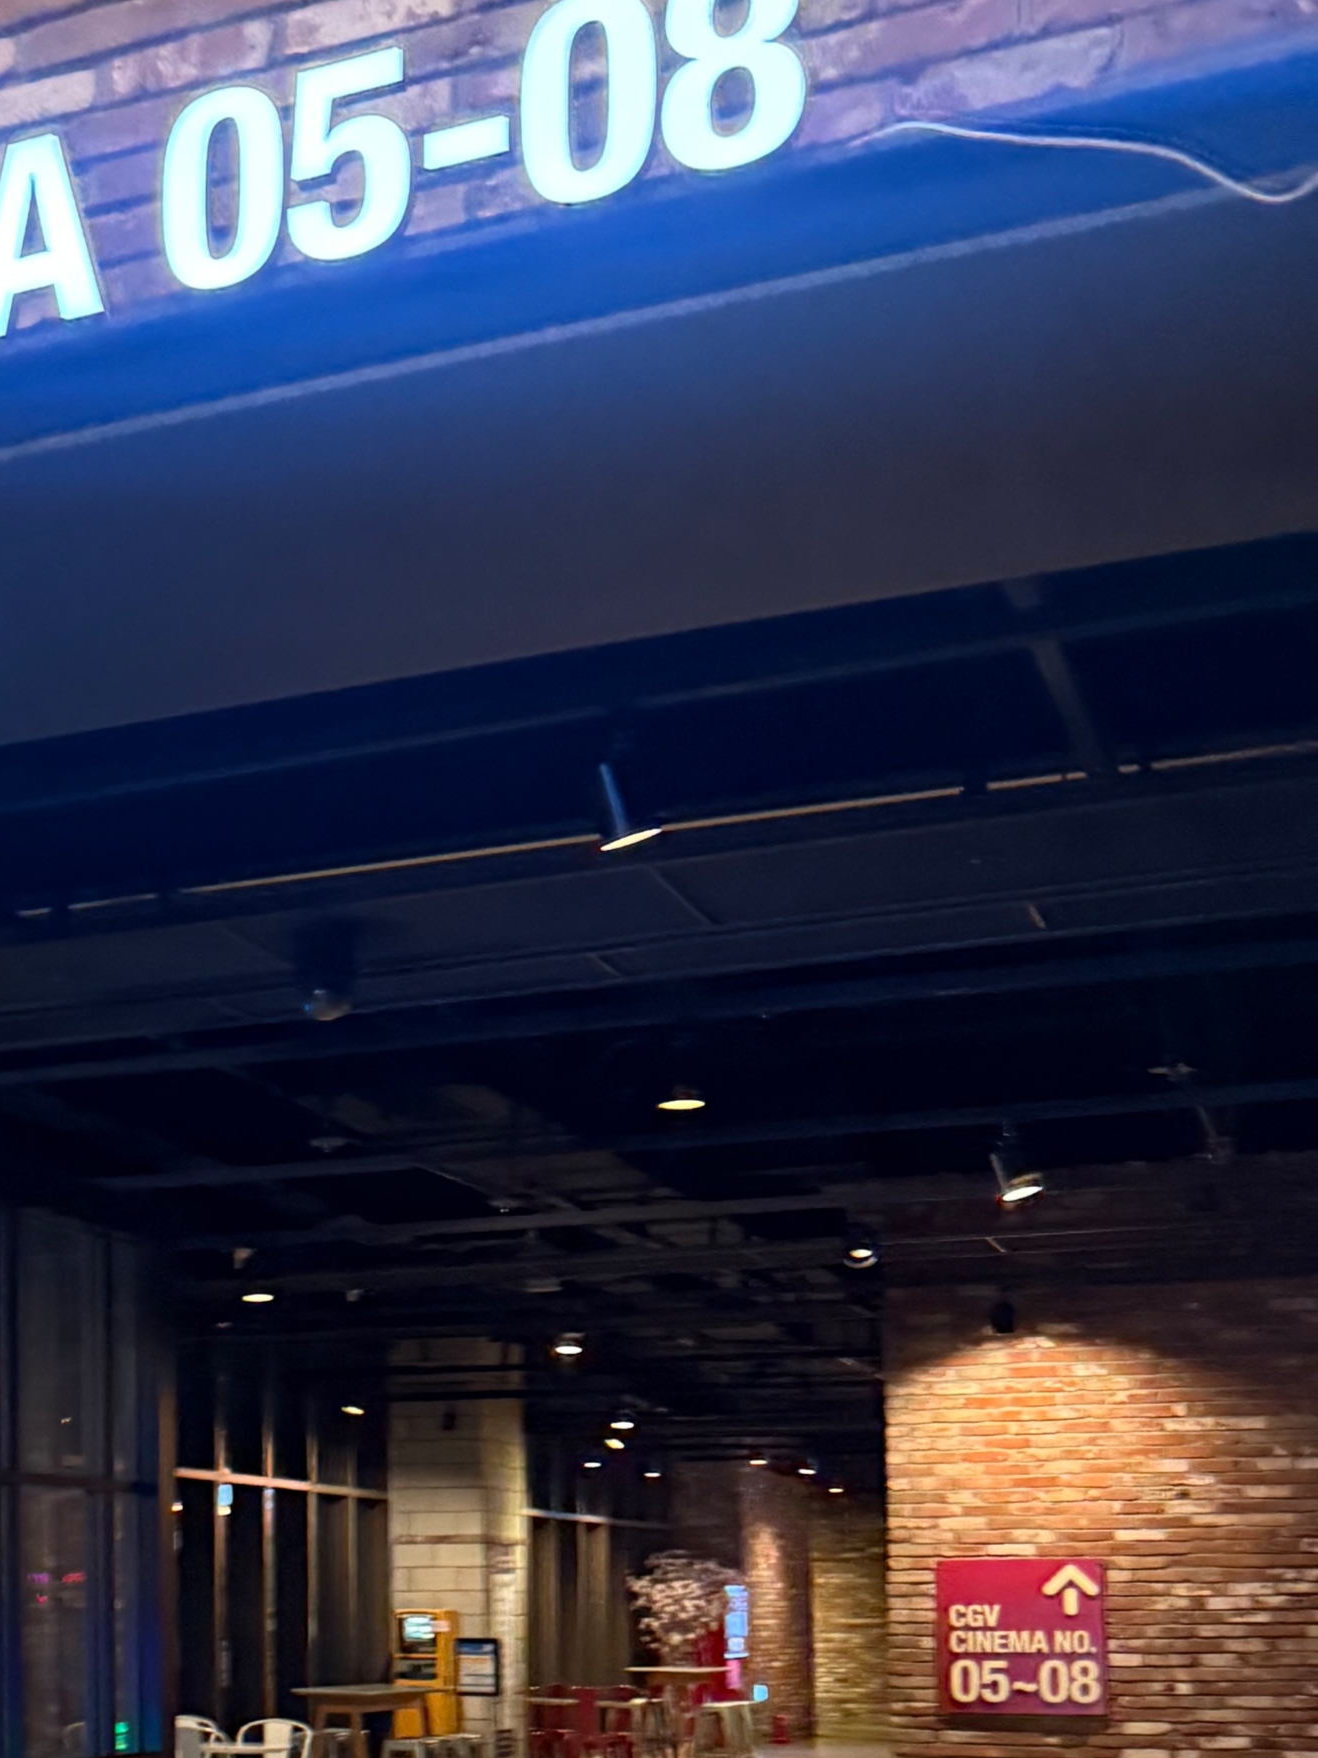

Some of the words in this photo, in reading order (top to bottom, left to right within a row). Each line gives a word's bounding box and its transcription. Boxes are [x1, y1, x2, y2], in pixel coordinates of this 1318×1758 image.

[159, 0, 808, 291] 05-08
[948, 1604, 1002, 1628] CGV
[949, 1630, 1049, 1653] CINEMA
[1053, 1630, 1097, 1654] NO.
[950, 1658, 1102, 1704] 05~08
